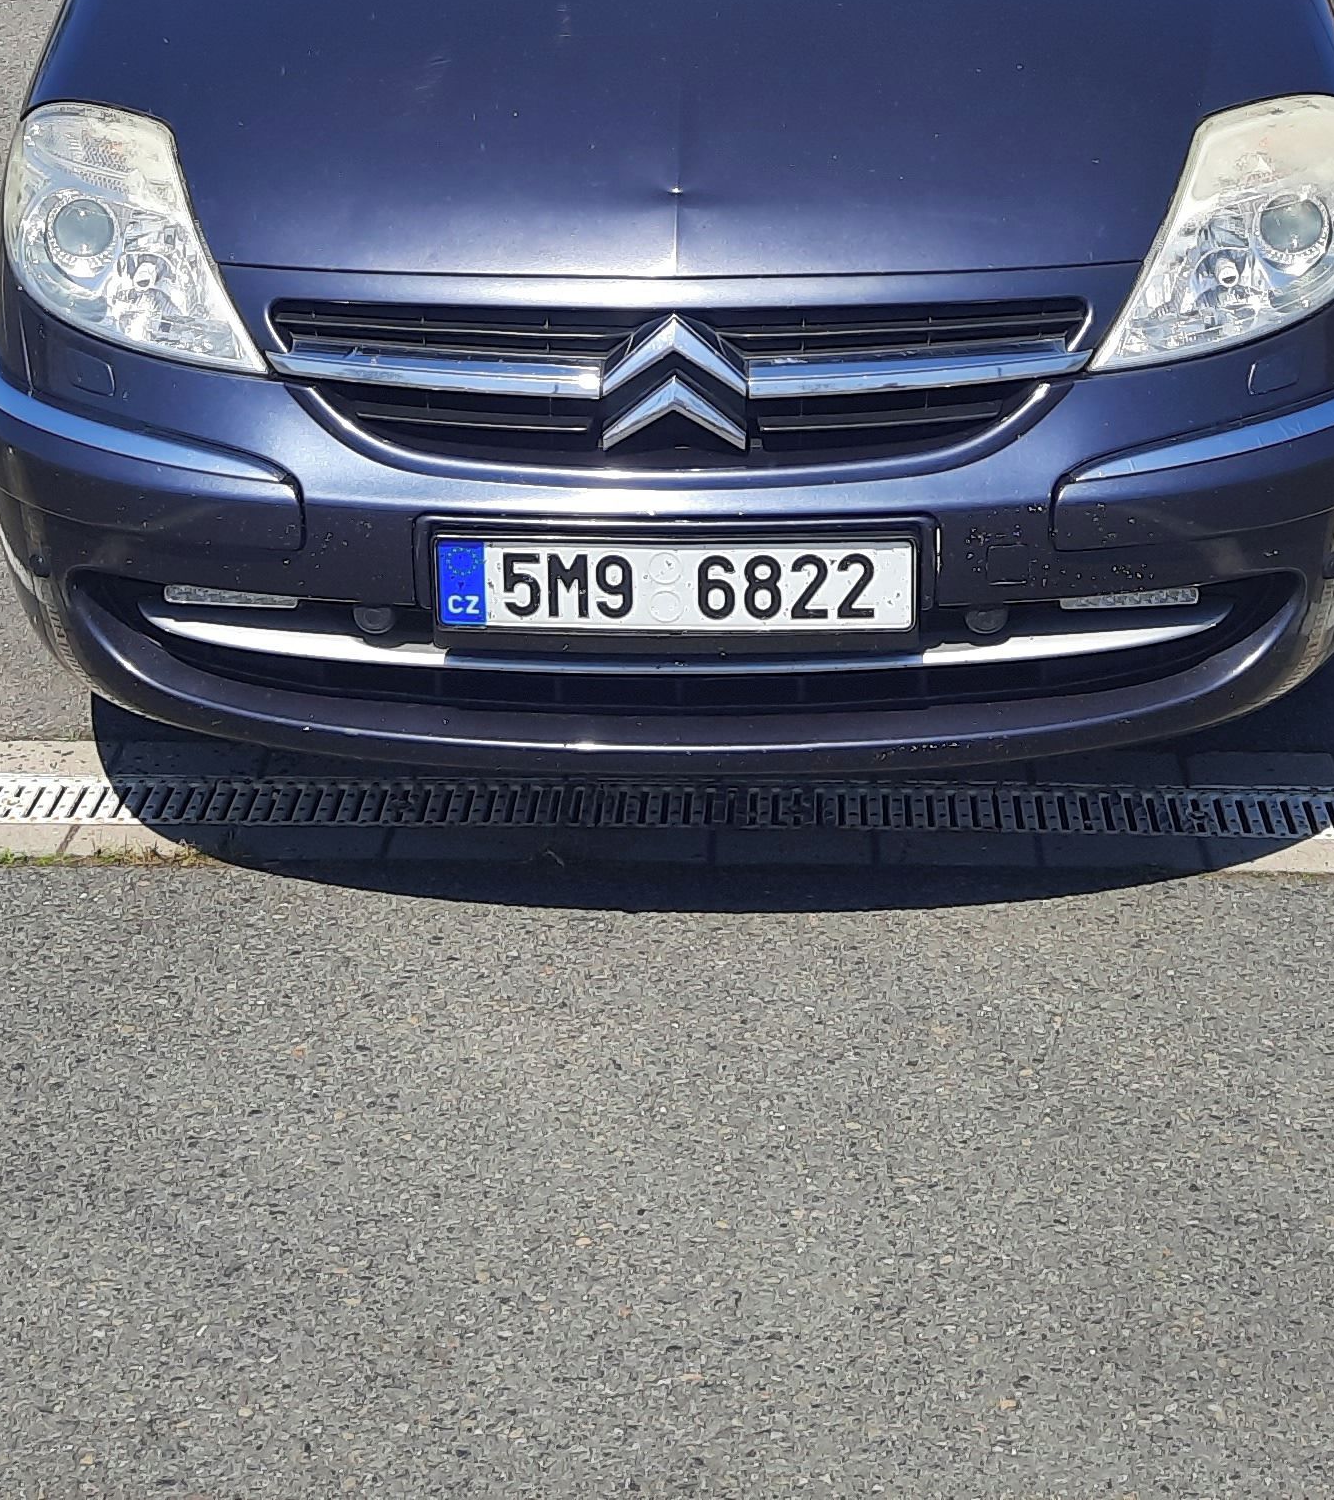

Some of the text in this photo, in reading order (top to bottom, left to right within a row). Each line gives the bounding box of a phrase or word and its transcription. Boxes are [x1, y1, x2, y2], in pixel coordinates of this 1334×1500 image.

[447, 595, 480, 615] CZ
[502, 553, 876, 620] 5M9 6822
